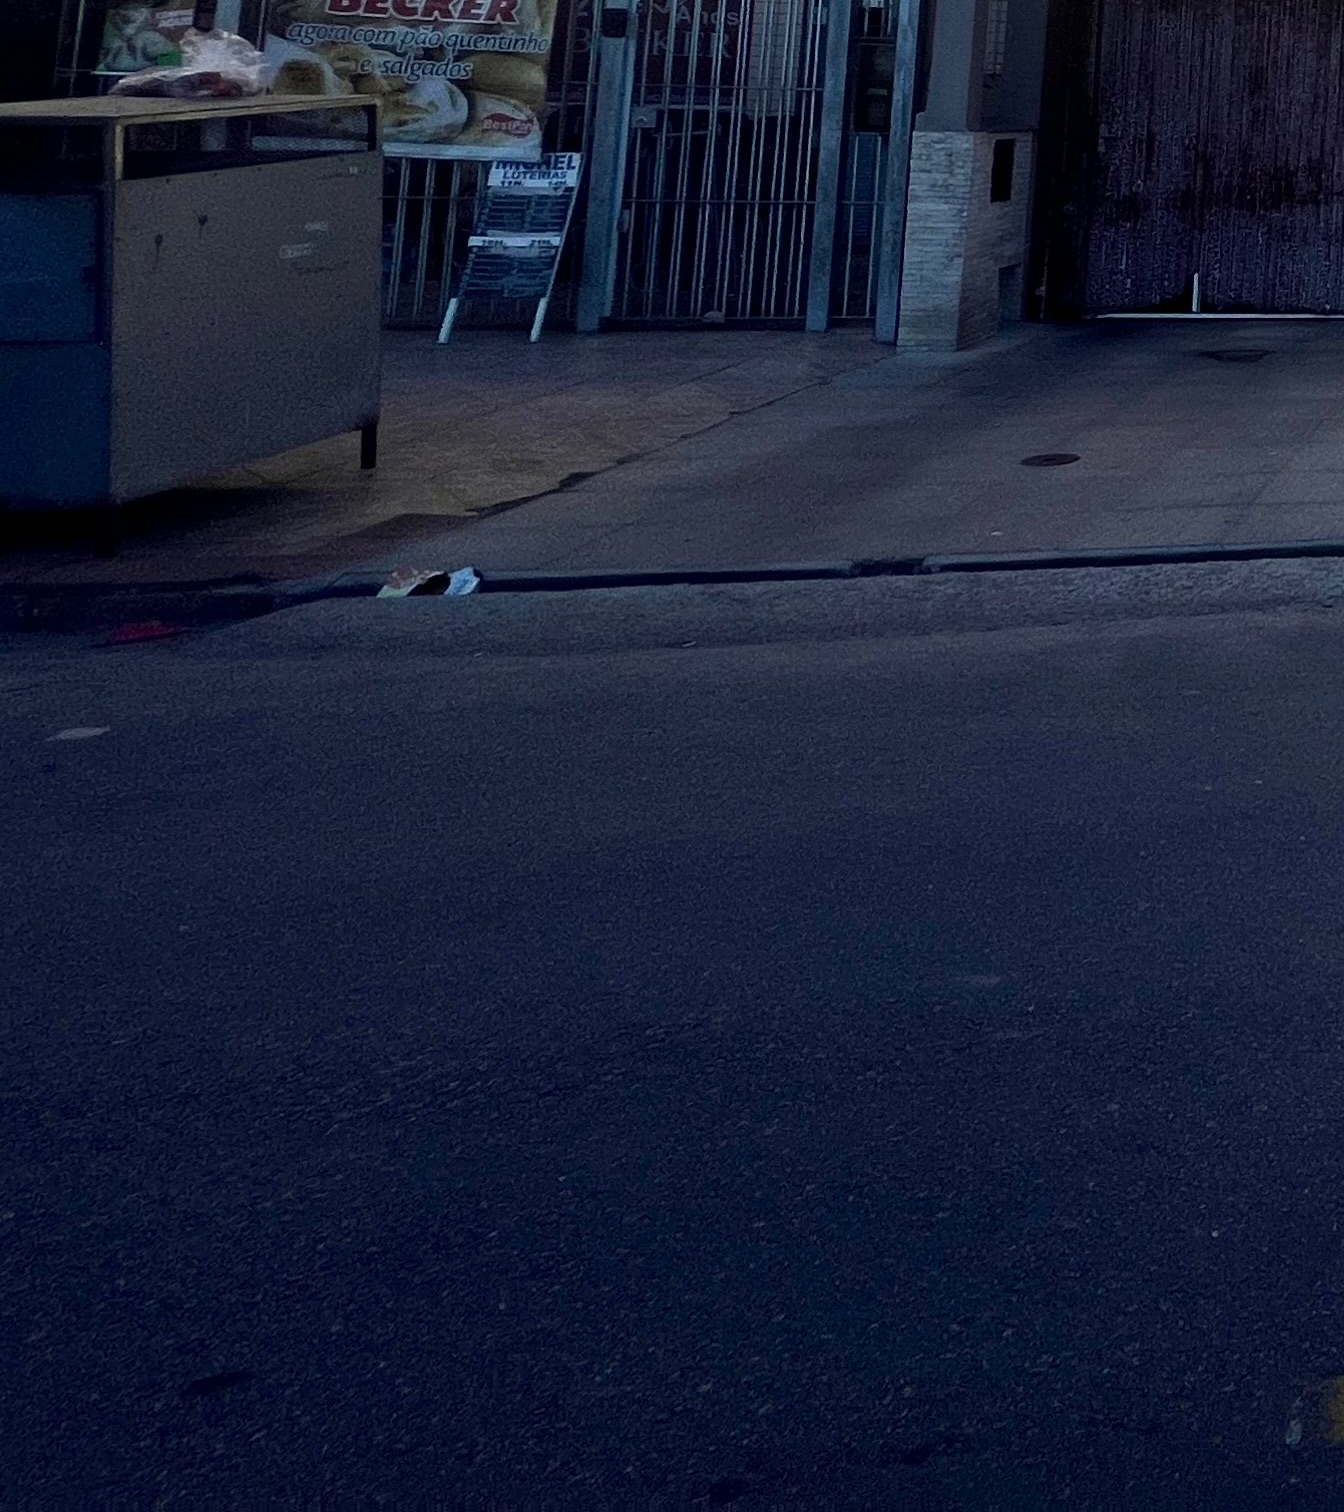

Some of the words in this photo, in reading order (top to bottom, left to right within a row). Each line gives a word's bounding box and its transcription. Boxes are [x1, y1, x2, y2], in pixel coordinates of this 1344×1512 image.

[287, 23, 352, 46] agora
[353, 26, 397, 46] com
[399, 25, 442, 53] pão
[446, 29, 549, 54] quentinho
[360, 57, 372, 74] e
[379, 55, 474, 84] salgados
